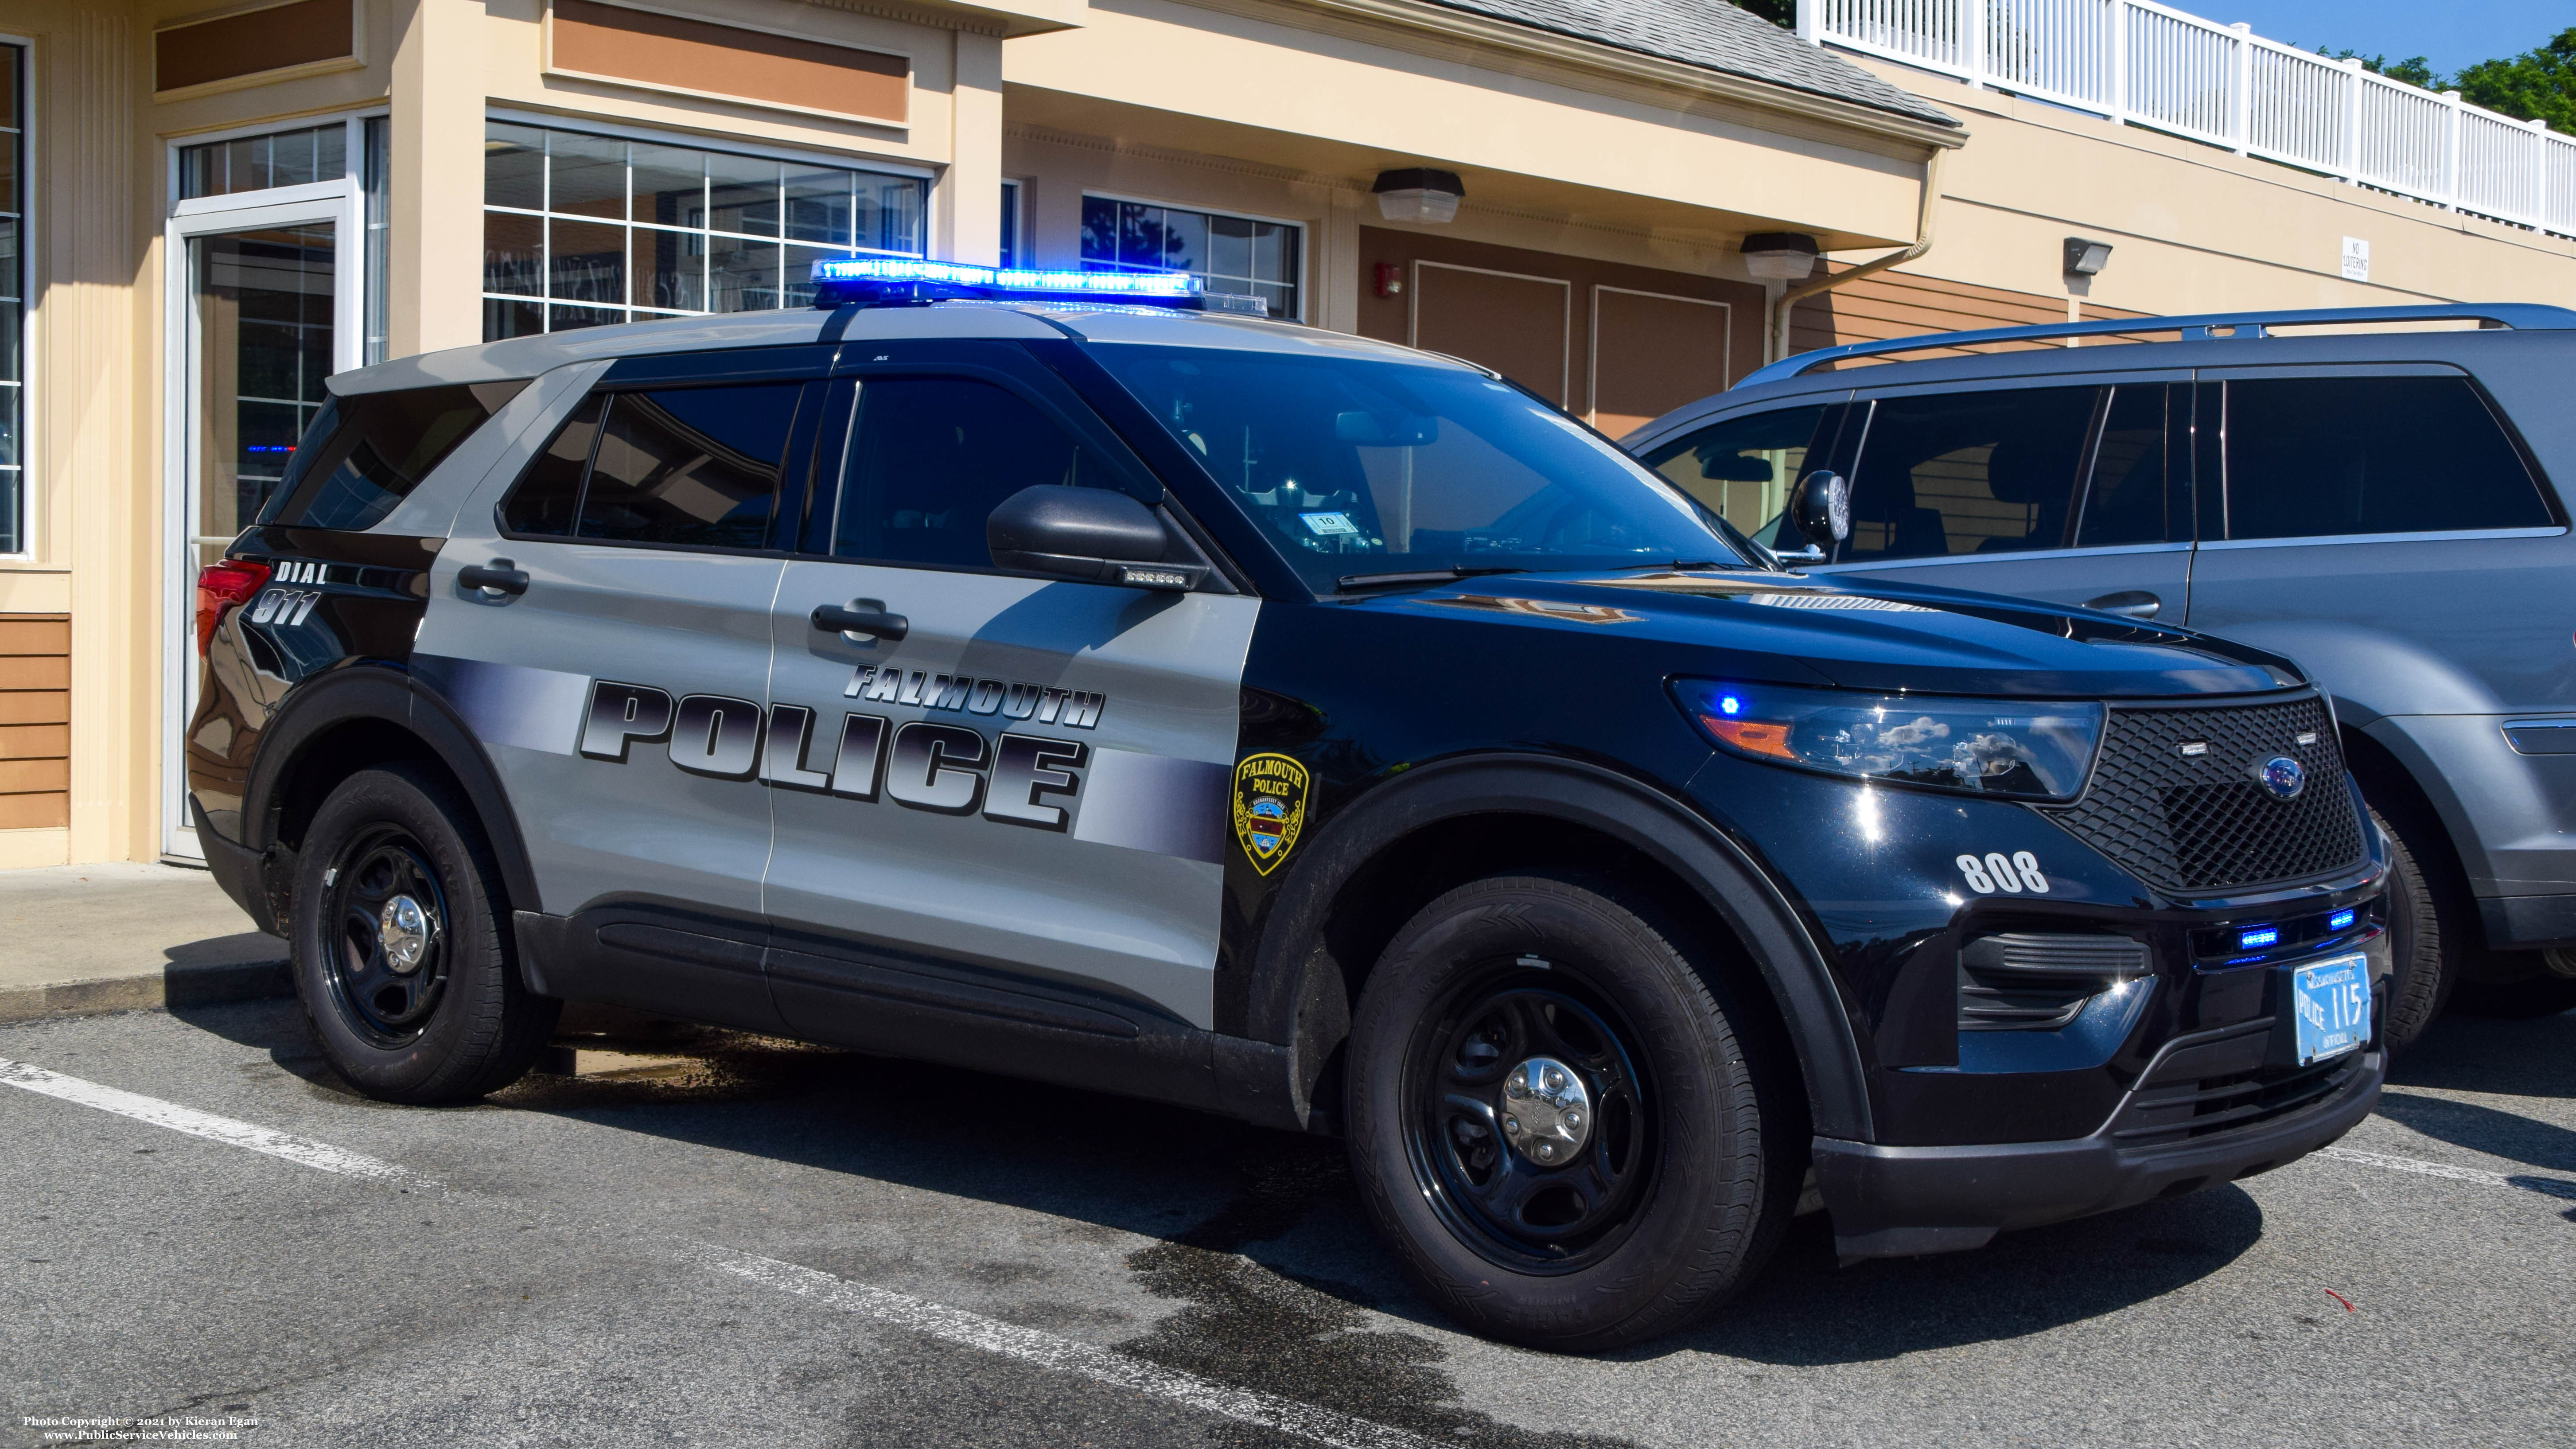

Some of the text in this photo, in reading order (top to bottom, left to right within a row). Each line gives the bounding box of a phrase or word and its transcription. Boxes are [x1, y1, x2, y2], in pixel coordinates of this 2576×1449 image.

[2352, 242, 2359, 254] NO
[2343, 255, 2367, 271] LOITERING
[275, 561, 327, 584] DIAL
[252, 588, 322, 627] 911
[844, 663, 1106, 730] FALMOUTH
[580, 678, 1090, 833] POLICE
[1241, 760, 1303, 789] FALMOUTH
[1253, 778, 1290, 796] POLICE
[1956, 851, 2049, 894] 808
[2298, 982, 2362, 1033] POLICE 115
[2323, 1032, 2348, 1049] OFFICIAL
